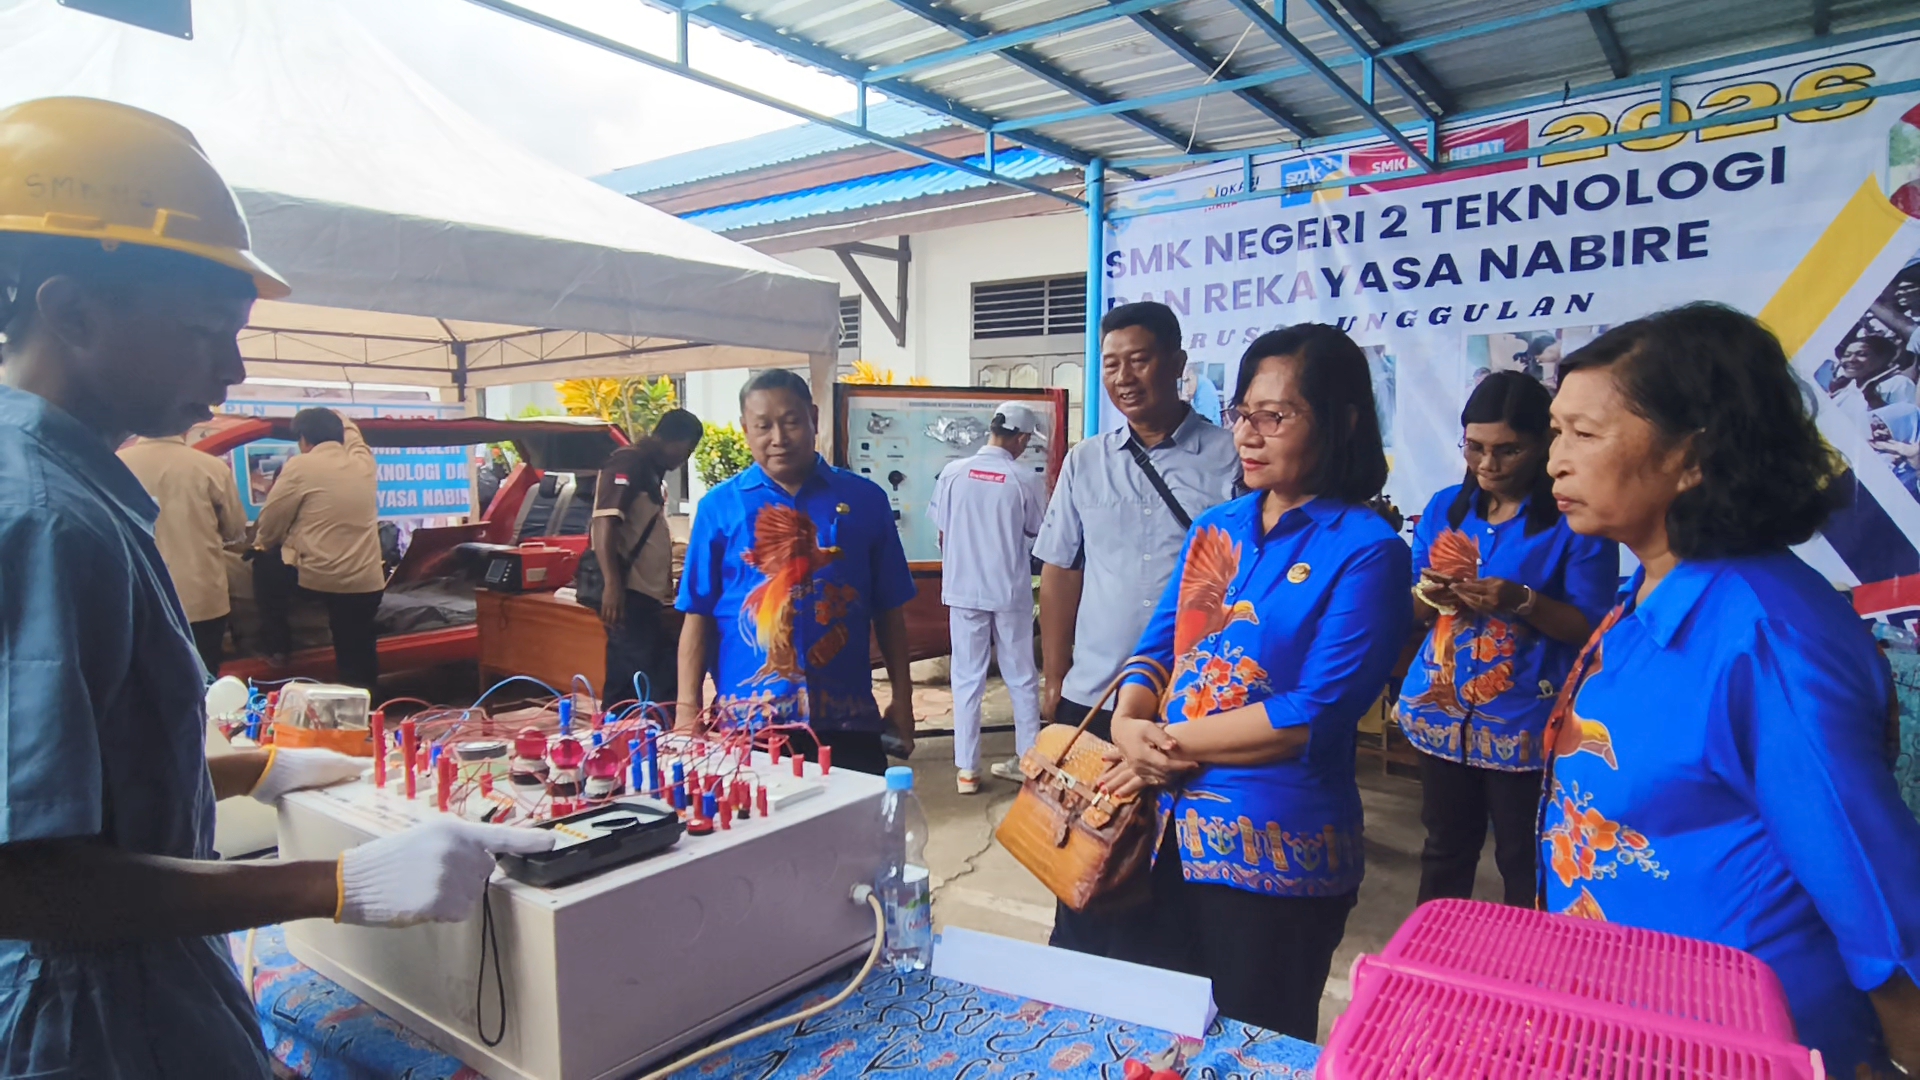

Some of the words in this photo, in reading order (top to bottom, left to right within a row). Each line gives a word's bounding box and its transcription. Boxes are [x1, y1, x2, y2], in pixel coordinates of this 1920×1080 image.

[1537, 62, 1876, 167] 2026
[1372, 157, 1406, 174] SMK
[1106, 239, 1192, 279] SMK
[1204, 211, 1365, 265] NEGERI
[1379, 205, 1408, 239] 2
[1422, 146, 1786, 233] TEKNOLOGI
[1204, 253, 1463, 314] REKAYASA
[1479, 219, 1710, 282] NABIRE
[1335, 292, 1595, 333] UNGGULAN
[376, 463, 441, 481] KNOLOGI
[445, 463, 470, 479] DA
[376, 489, 418, 508] YASA
